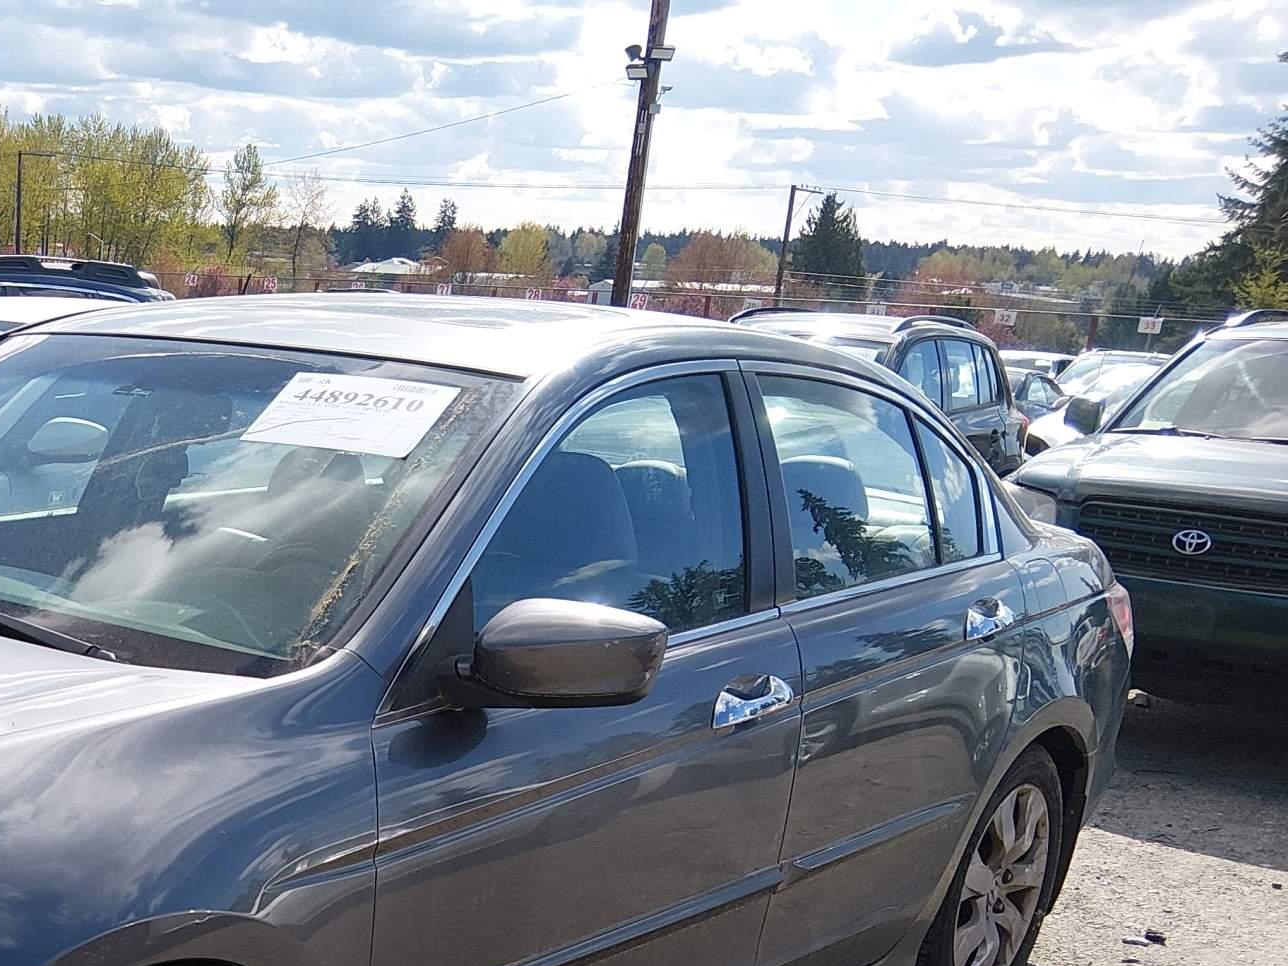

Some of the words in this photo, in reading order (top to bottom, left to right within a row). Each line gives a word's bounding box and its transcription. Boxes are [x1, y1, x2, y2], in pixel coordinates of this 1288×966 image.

[186, 274, 196, 285] 24
[265, 278, 276, 289] 25
[528, 288, 540, 299] 28
[633, 294, 646, 307] 29
[999, 313, 1011, 322] 32
[1143, 322, 1155, 331] 33
[294, 388, 424, 413] 44892610
